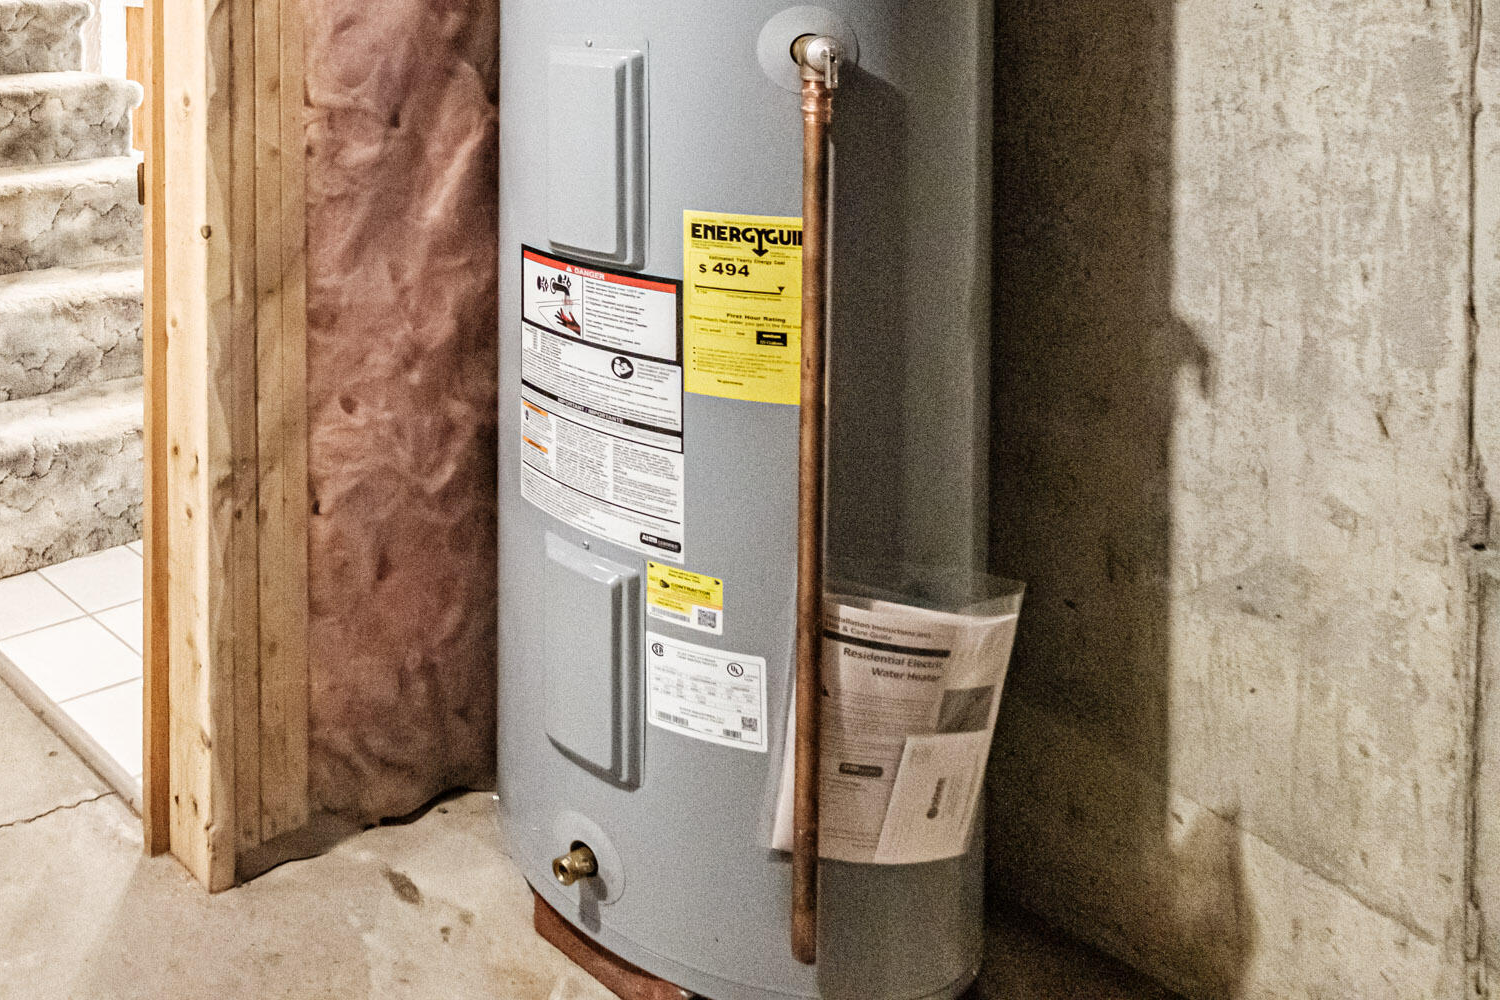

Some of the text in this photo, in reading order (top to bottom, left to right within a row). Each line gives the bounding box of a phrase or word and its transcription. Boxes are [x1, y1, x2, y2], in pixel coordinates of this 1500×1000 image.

[691, 222, 803, 248] ENERGYGUI
[574, 267, 605, 281] DANGER
[712, 262, 750, 278] 494
[843, 647, 905, 666] Residential
[871, 667, 942, 682] Water Heater
